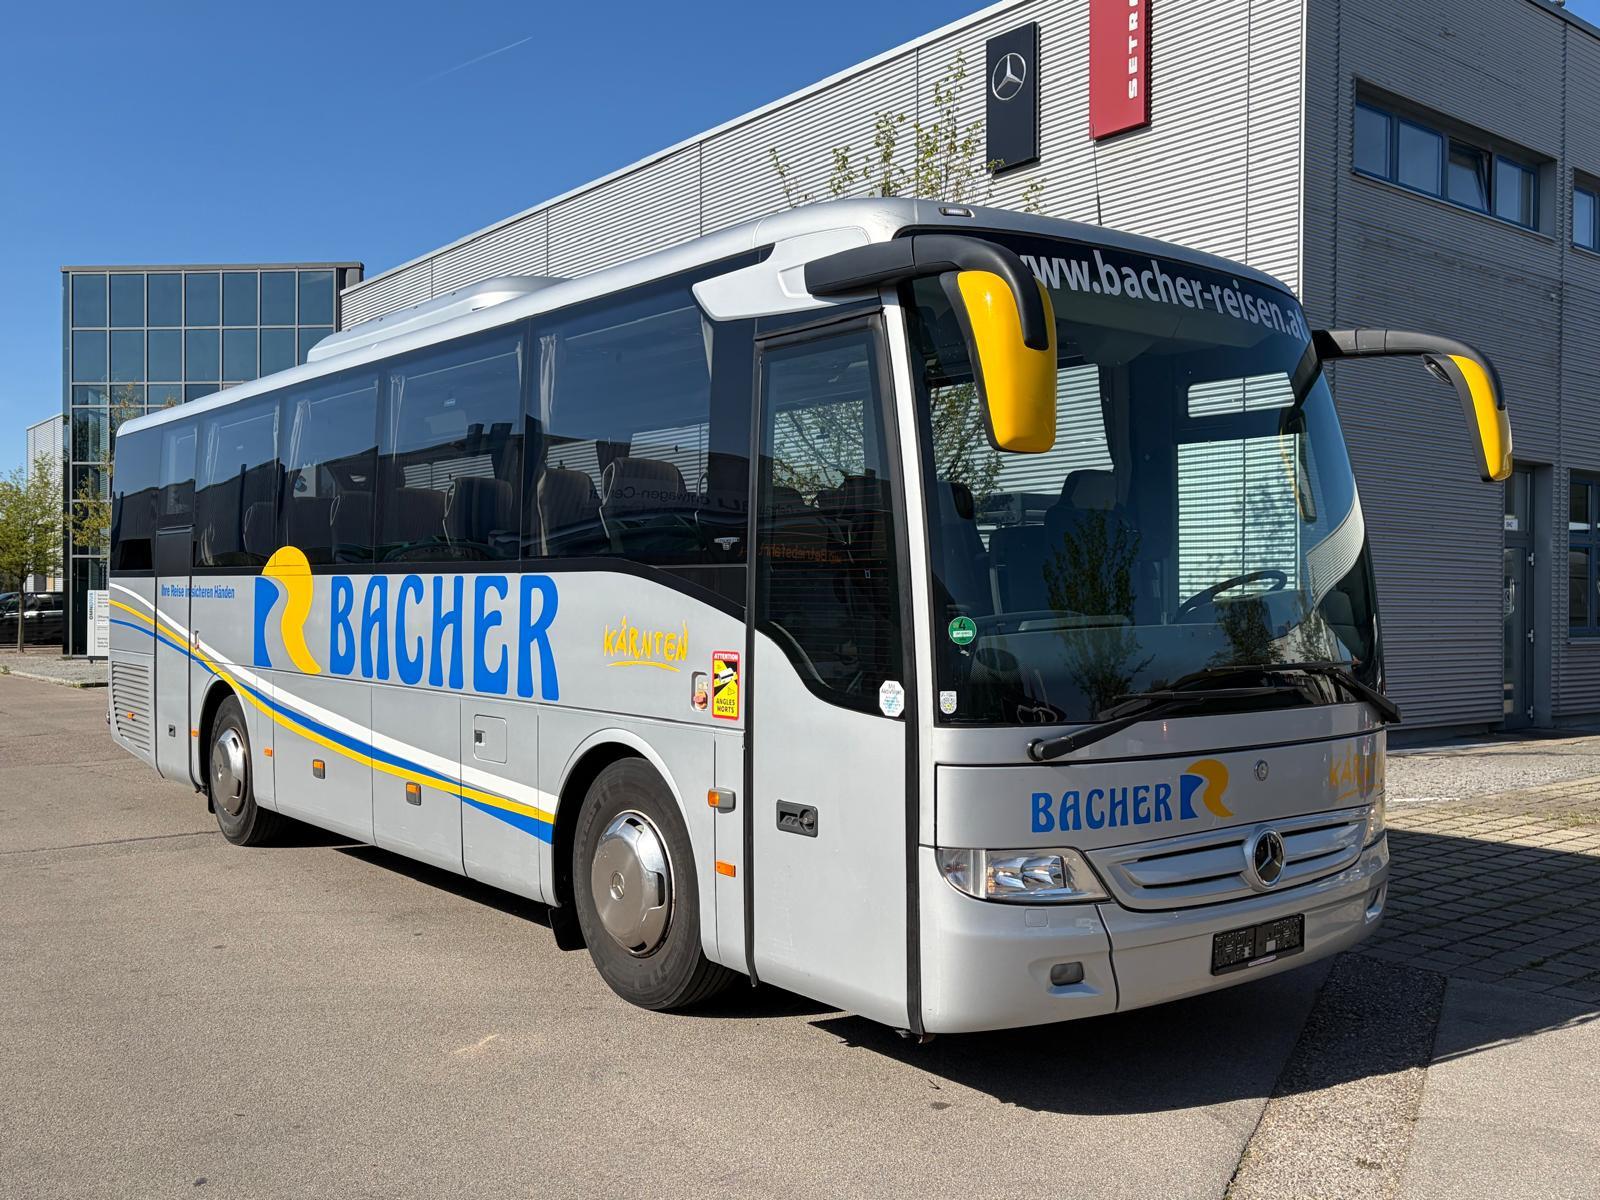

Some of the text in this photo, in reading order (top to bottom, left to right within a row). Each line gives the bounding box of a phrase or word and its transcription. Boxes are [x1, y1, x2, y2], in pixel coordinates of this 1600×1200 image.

[1020, 250, 1308, 344] ww.bacher-reisen.at
[161, 584, 170, 597] Ihre
[170, 584, 185, 598] Reise
[191, 585, 213, 599] sicheren
[213, 585, 235, 599] Händen
[958, 618, 966, 630] 4
[330, 575, 559, 701] BACHER
[714, 653, 739, 661] ATTENTION
[716, 698, 735, 706] ANGLES
[717, 705, 735, 714] MORTS
[1031, 782, 1172, 833] BACHER
